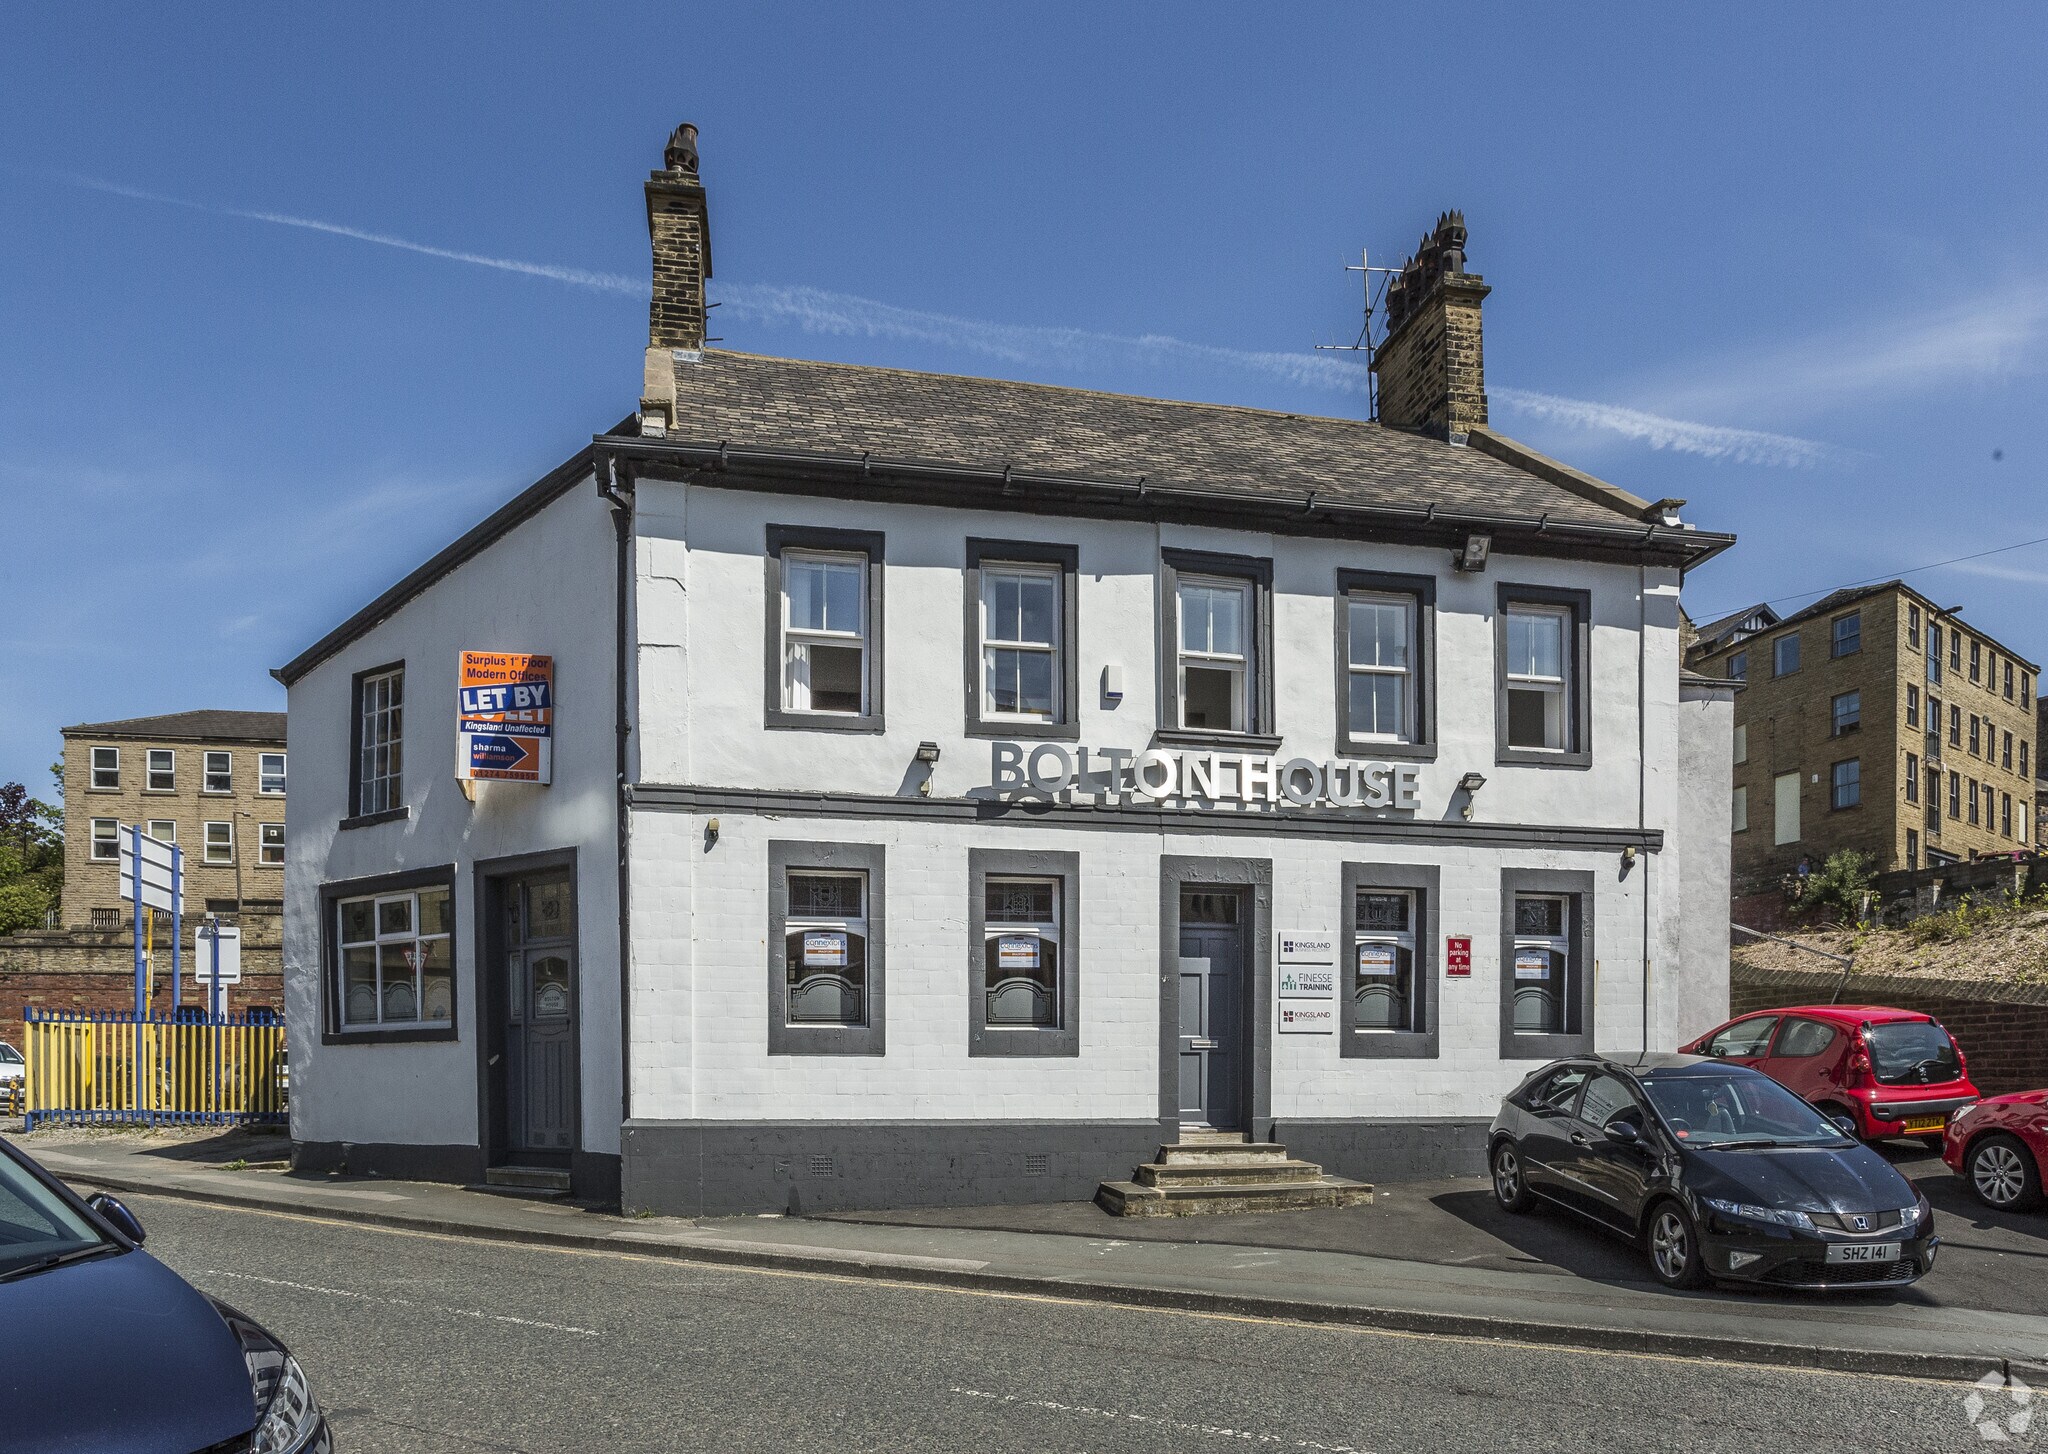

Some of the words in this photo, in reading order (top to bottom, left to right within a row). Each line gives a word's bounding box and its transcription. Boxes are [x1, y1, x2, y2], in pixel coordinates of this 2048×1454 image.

[466, 654, 506, 667] Surplus
[522, 657, 548, 668] Floor
[467, 668, 506, 680] Modern
[510, 670, 546, 681] Offices
[462, 688, 506, 712] LET
[514, 684, 545, 708] BY
[465, 722, 503, 732] Kingsland
[504, 724, 546, 734] Unaffected
[473, 744, 506, 752] sharma
[473, 752, 514, 761] williamson
[991, 741, 1221, 800] BOLTON
[1242, 754, 1421, 809] HOUSE
[1450, 950, 1468, 958] parking
[1298, 973, 1332, 982] FINESSE
[1842, 1247, 1868, 1260] SHZ
[1871, 1246, 1887, 1259] 141
